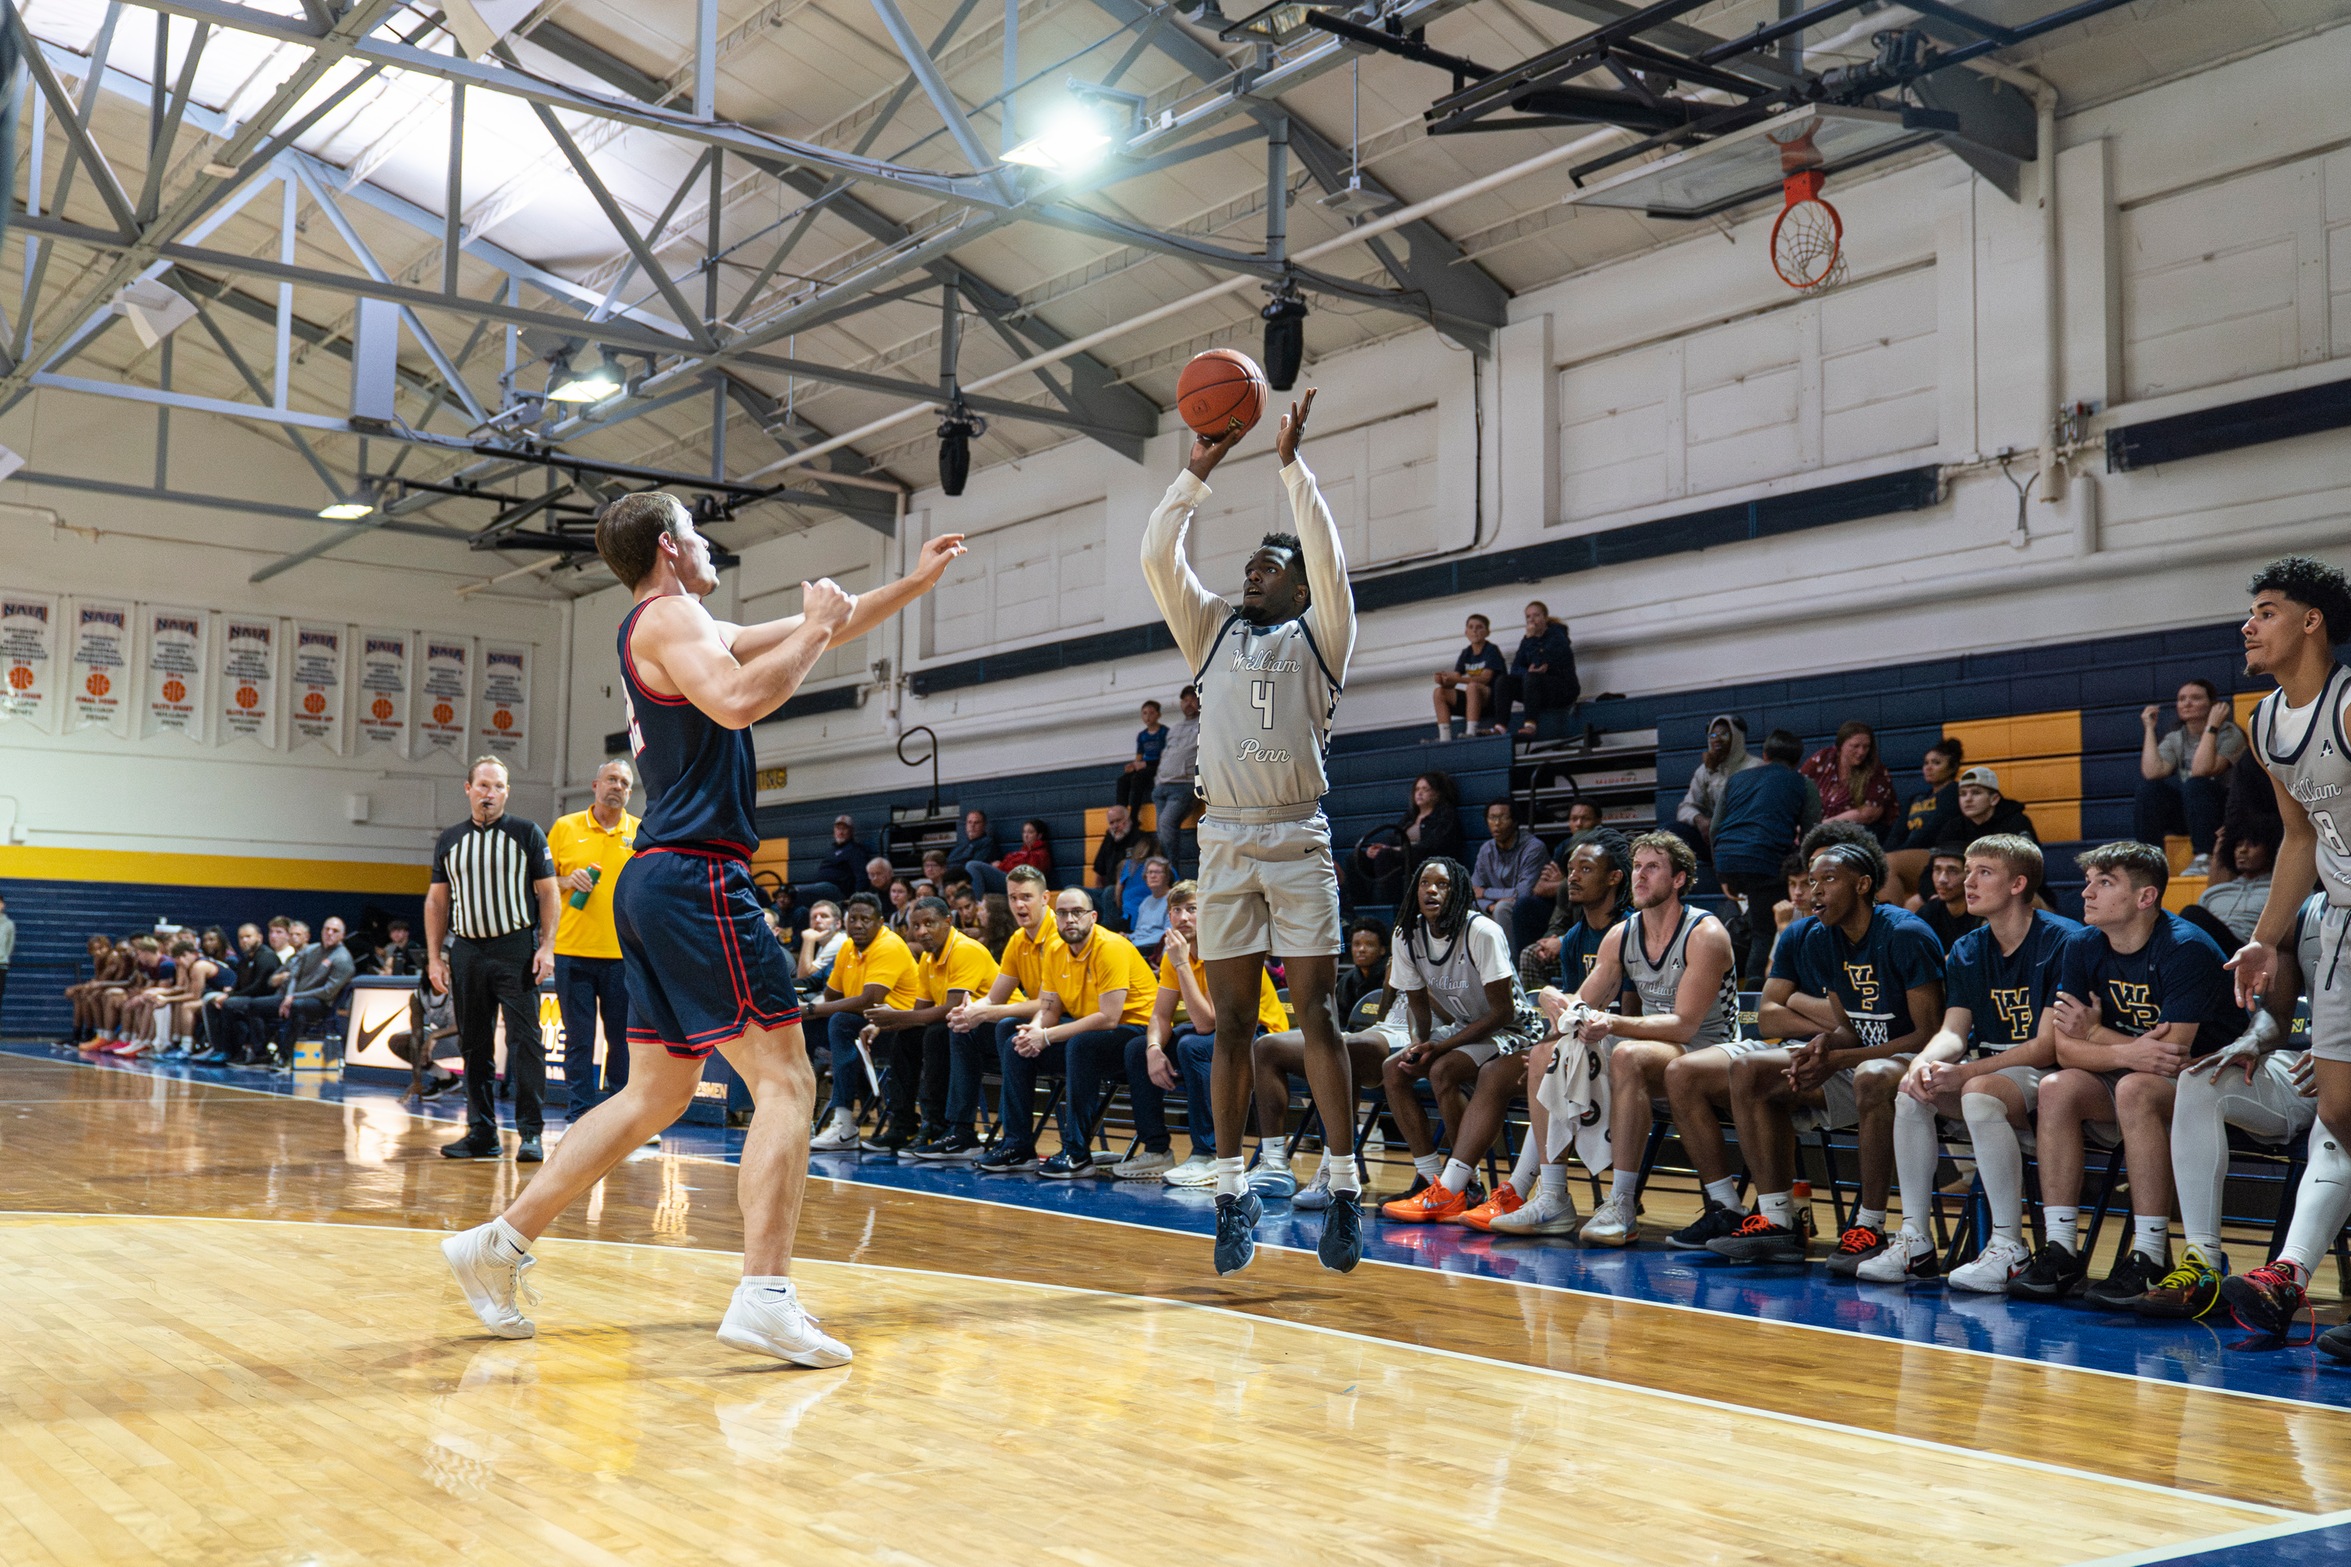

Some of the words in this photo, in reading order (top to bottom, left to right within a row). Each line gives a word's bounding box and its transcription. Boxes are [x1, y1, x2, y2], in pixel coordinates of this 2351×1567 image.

[1230, 649, 1301, 672] William
[1251, 680, 1275, 729] 4
[1237, 738, 1291, 762] Penn
[2313, 810, 2351, 857] 8
[1991, 987, 2033, 1040] WP
[2108, 980, 2162, 1028] WP
